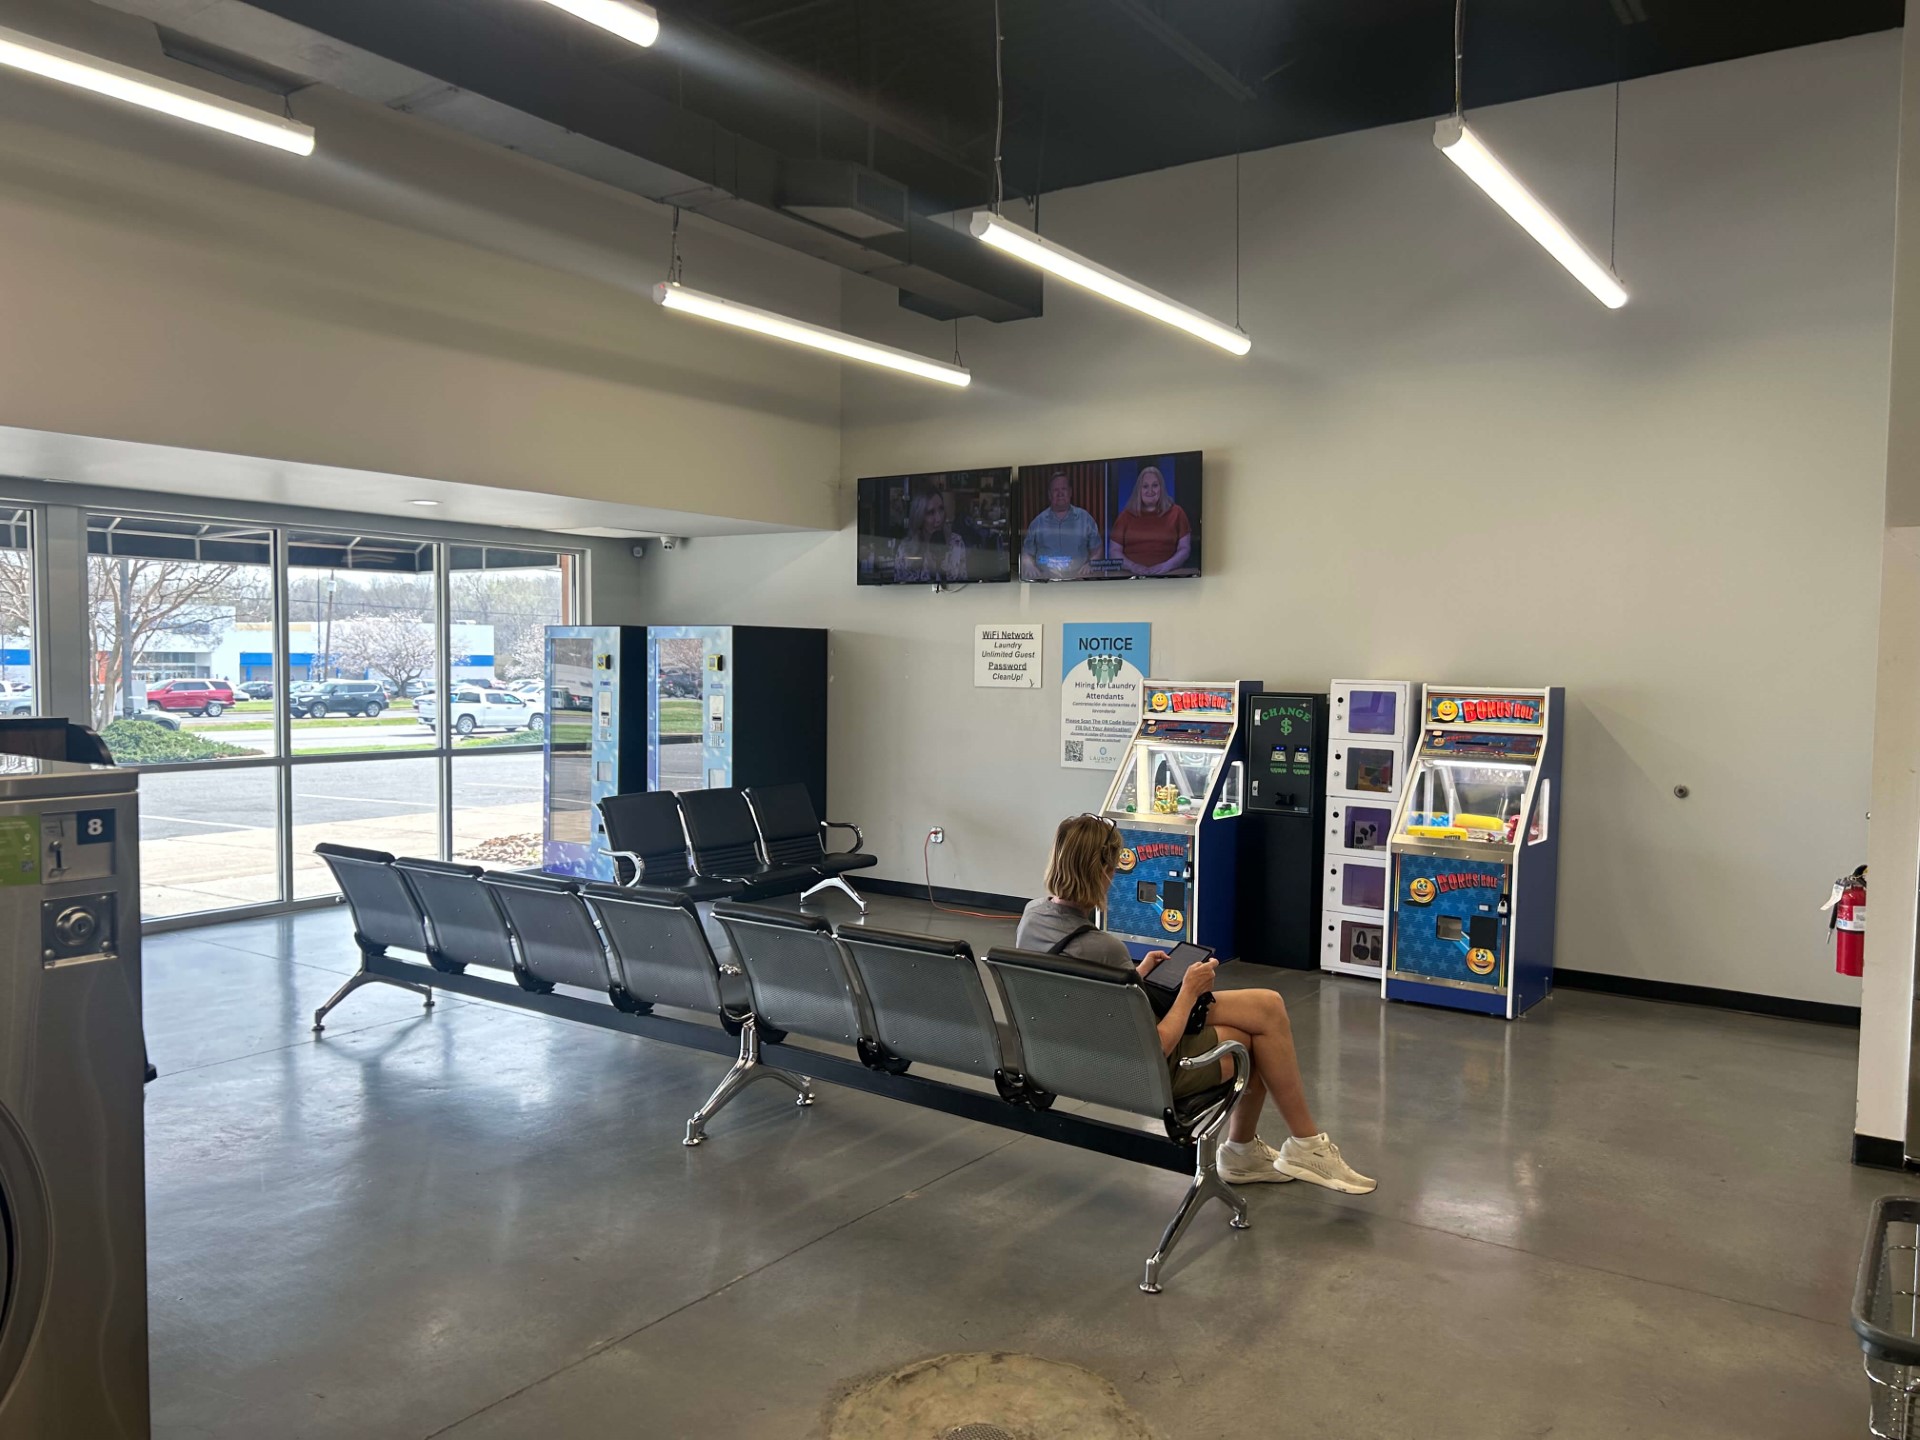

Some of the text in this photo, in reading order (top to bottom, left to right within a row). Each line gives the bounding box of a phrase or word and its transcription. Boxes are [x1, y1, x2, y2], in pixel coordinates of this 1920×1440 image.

[982, 631, 1034, 640] WiFi Network
[994, 642, 1022, 650] Laundry
[1079, 637, 1133, 651] NOTICE
[988, 662, 1027, 670] Password
[992, 673, 1024, 682] CleanUp!
[1075, 682, 1095, 690] Hiring
[1107, 682, 1136, 691] Laundry
[1170, 692, 1228, 713] BONUS HOLE
[1261, 707, 1311, 722] CHANGE
[1462, 700, 1535, 723] BONUS HOLE
[87, 818, 103, 835] 8
[1136, 843, 1184, 862] BONUS HOLE
[1436, 873, 1498, 893] BONUS HOLE
